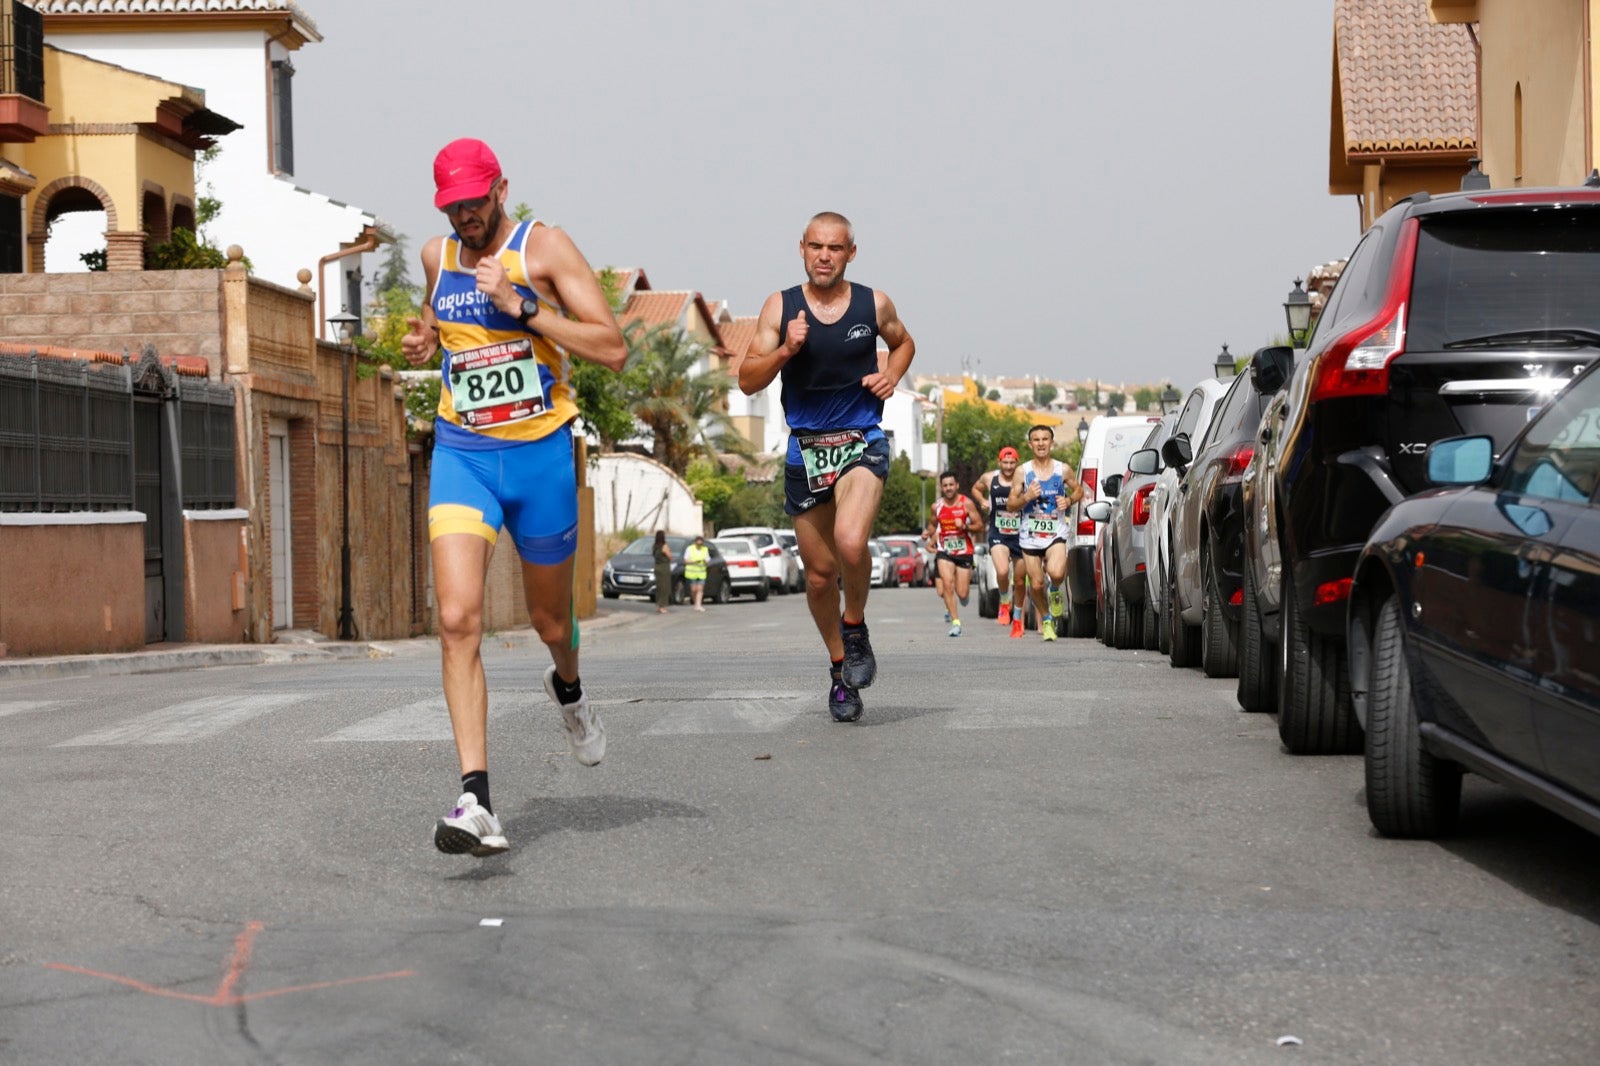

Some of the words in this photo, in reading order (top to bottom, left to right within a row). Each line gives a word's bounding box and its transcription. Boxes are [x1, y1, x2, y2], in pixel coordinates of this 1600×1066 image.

[467, 366, 525, 402] 820
[1000, 518, 1017, 527] 660
[1034, 519, 1054, 531] 793
